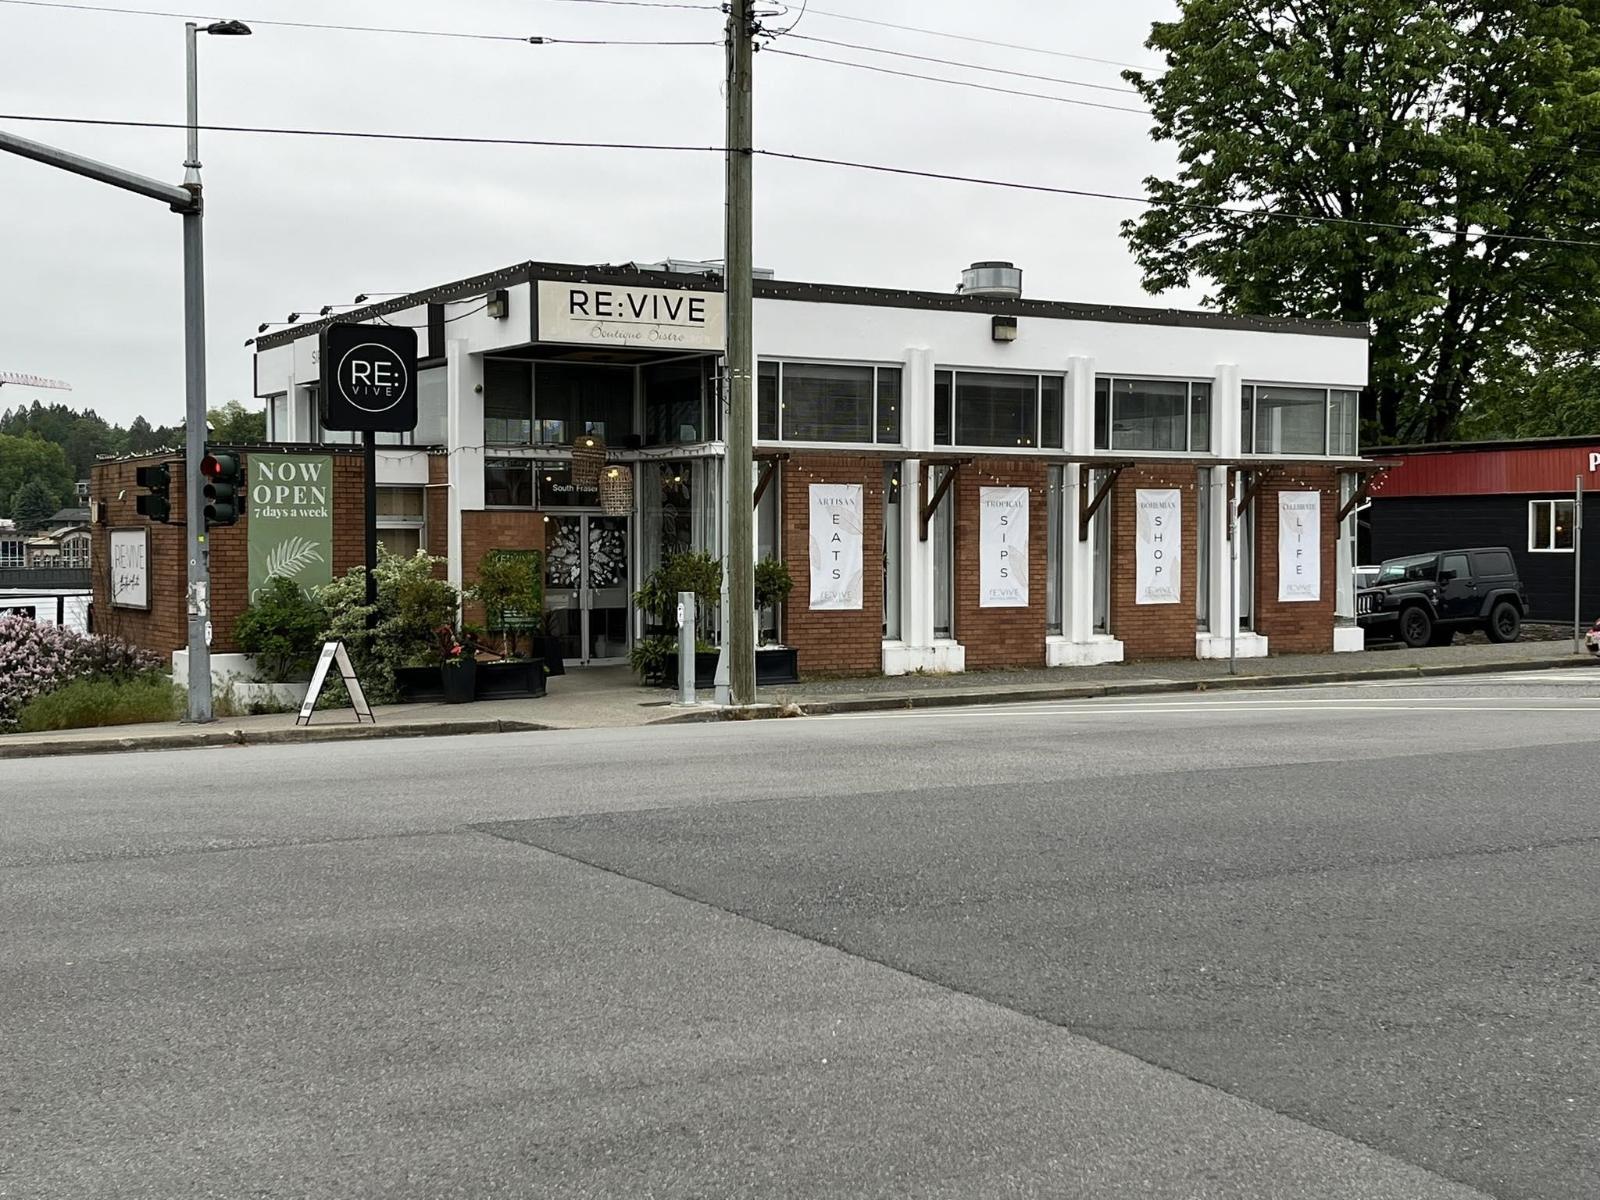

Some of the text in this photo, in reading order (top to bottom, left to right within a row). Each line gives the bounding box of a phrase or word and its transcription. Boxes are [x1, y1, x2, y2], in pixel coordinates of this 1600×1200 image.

[569, 289, 705, 322] RE:VIVE
[590, 322, 685, 346] Boutique Bistro
[352, 360, 399, 387] RE:
[352, 386, 392, 397] VIVE
[258, 462, 322, 482] NOW
[253, 485, 327, 505] OPEN
[552, 484, 574, 492] South
[254, 505, 328, 519] 7 days a week
[818, 498, 856, 506] ARTISAN
[986, 500, 1024, 508] TROPICAL
[831, 514, 842, 580] EATS
[1000, 515, 1009, 578] SIPS
[1154, 516, 1163, 576] SHOP
